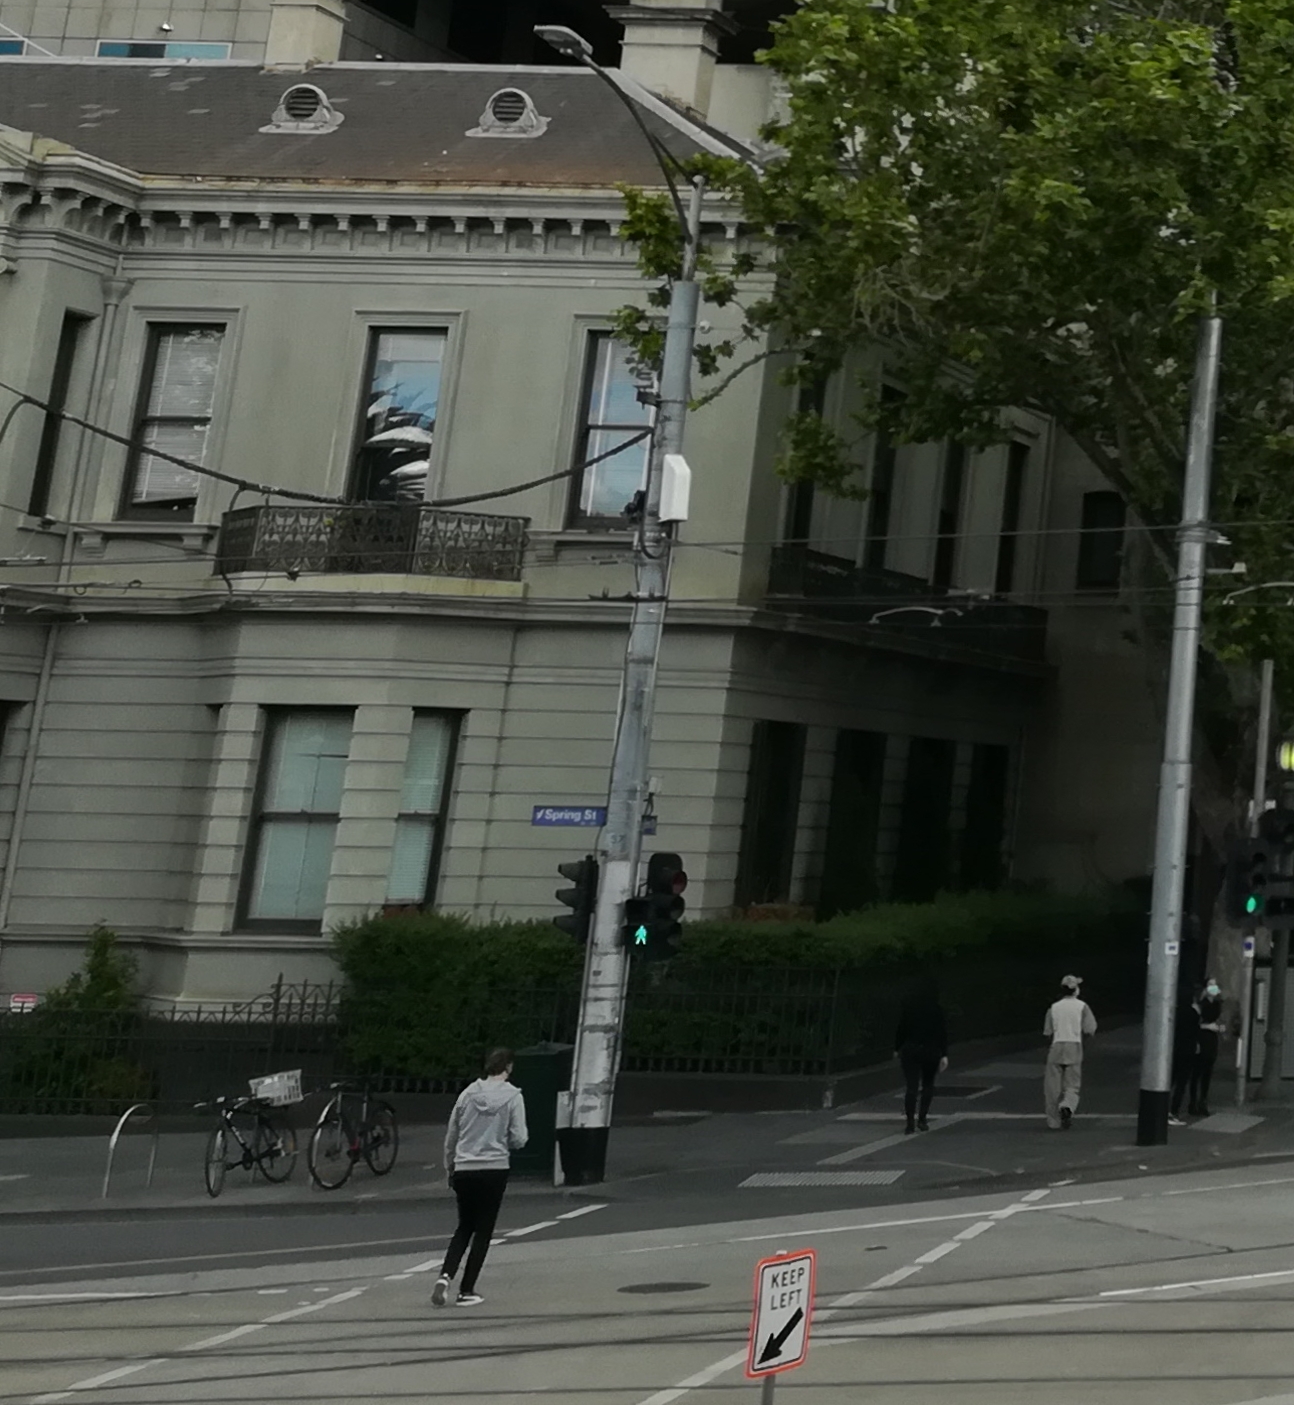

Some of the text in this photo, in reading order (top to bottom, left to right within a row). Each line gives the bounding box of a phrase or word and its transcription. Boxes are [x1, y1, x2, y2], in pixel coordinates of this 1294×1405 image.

[545, 809, 597, 822] Spring St
[771, 1267, 805, 1289] KEEP
[770, 1288, 802, 1311] LEFT
